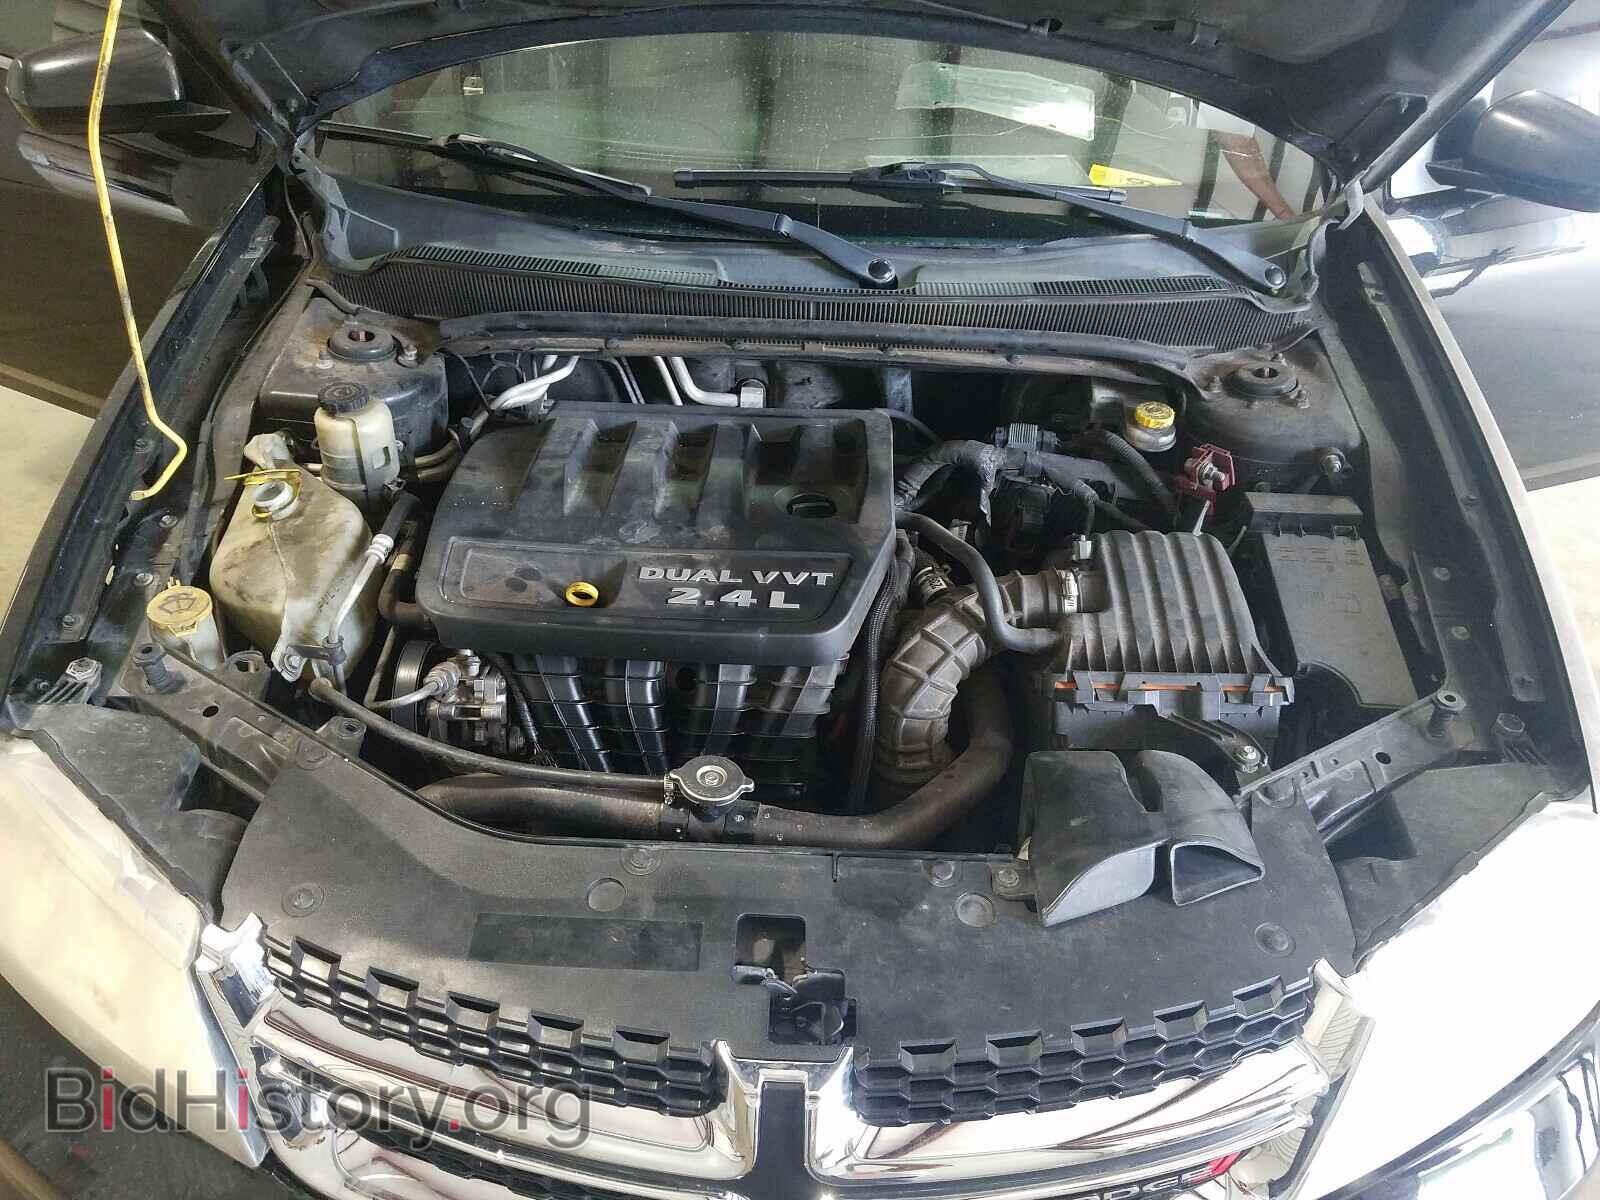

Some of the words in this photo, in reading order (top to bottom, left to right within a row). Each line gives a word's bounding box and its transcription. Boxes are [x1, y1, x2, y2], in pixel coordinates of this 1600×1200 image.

[639, 566, 743, 584] DUAL
[752, 570, 834, 586] VVT
[1073, 1167, 1213, 1200] DGE
